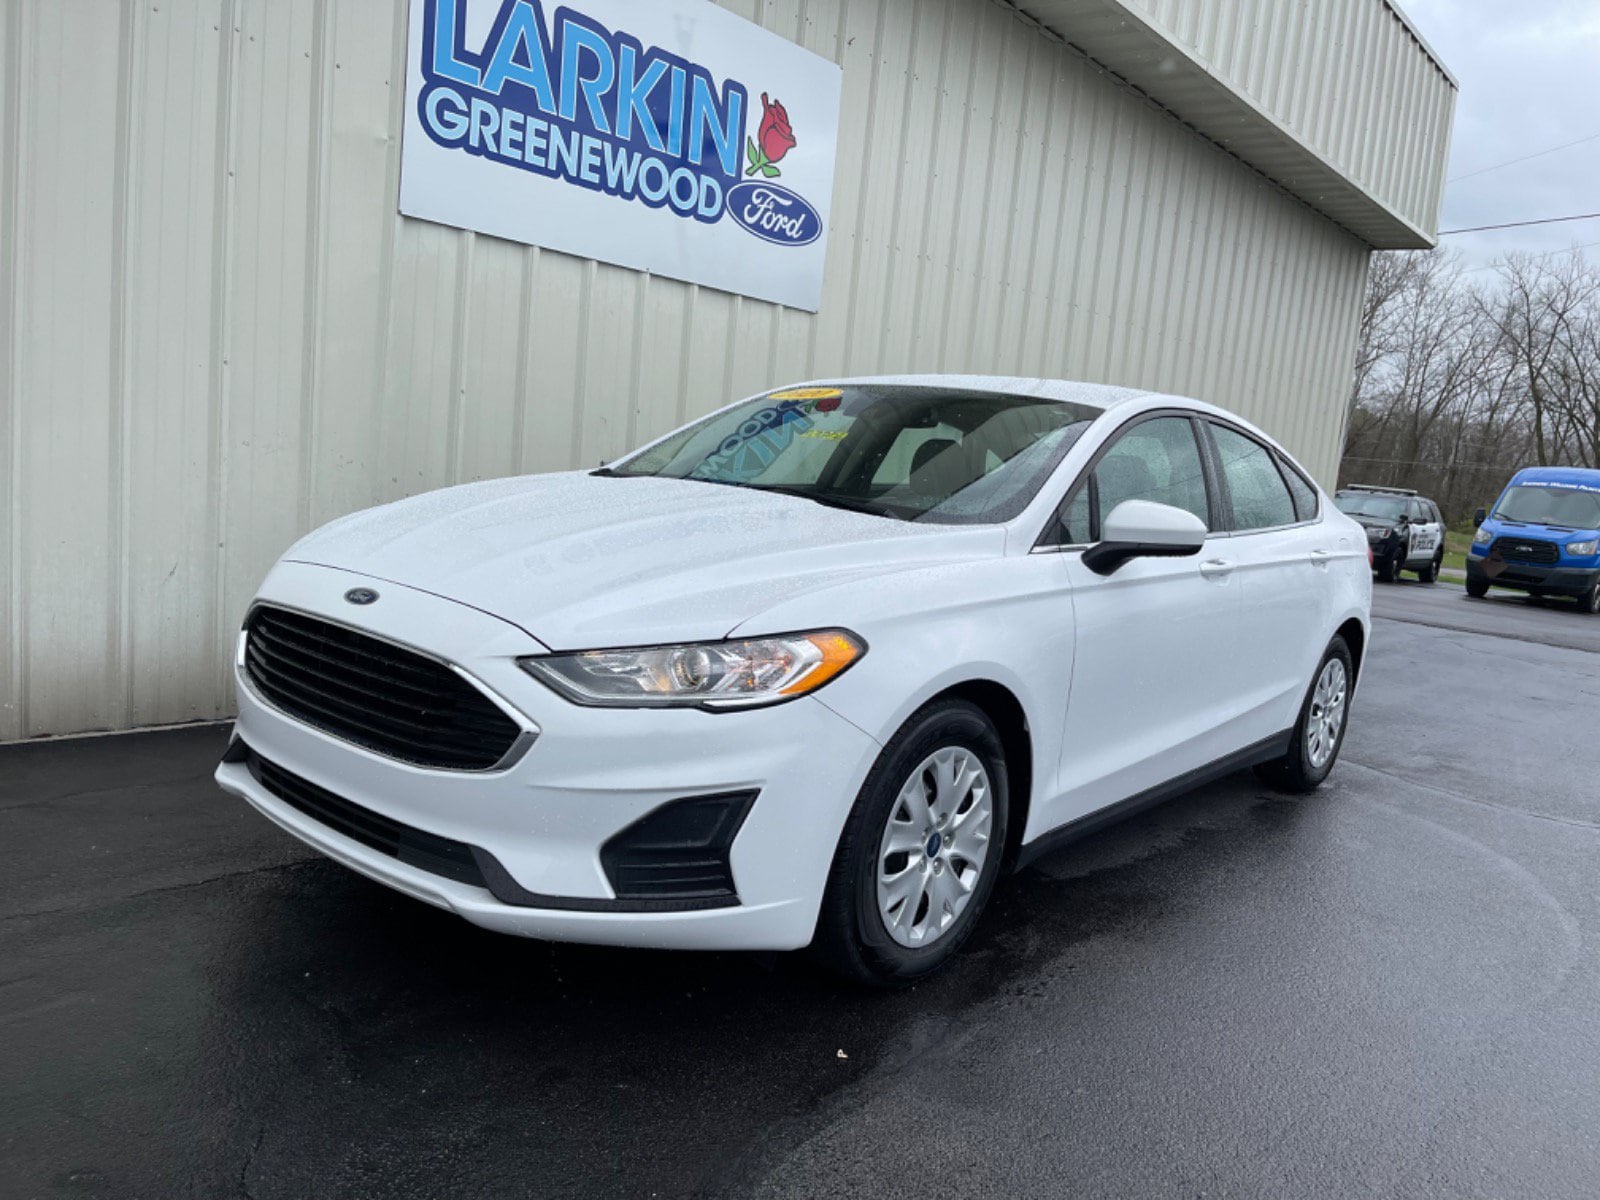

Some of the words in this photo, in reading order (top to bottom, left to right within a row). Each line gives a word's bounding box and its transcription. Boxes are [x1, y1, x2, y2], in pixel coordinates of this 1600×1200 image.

[424, 86, 723, 218] GREENEWOOD
[433, 0, 742, 177] LARKIN
[743, 188, 806, 239] Ford
